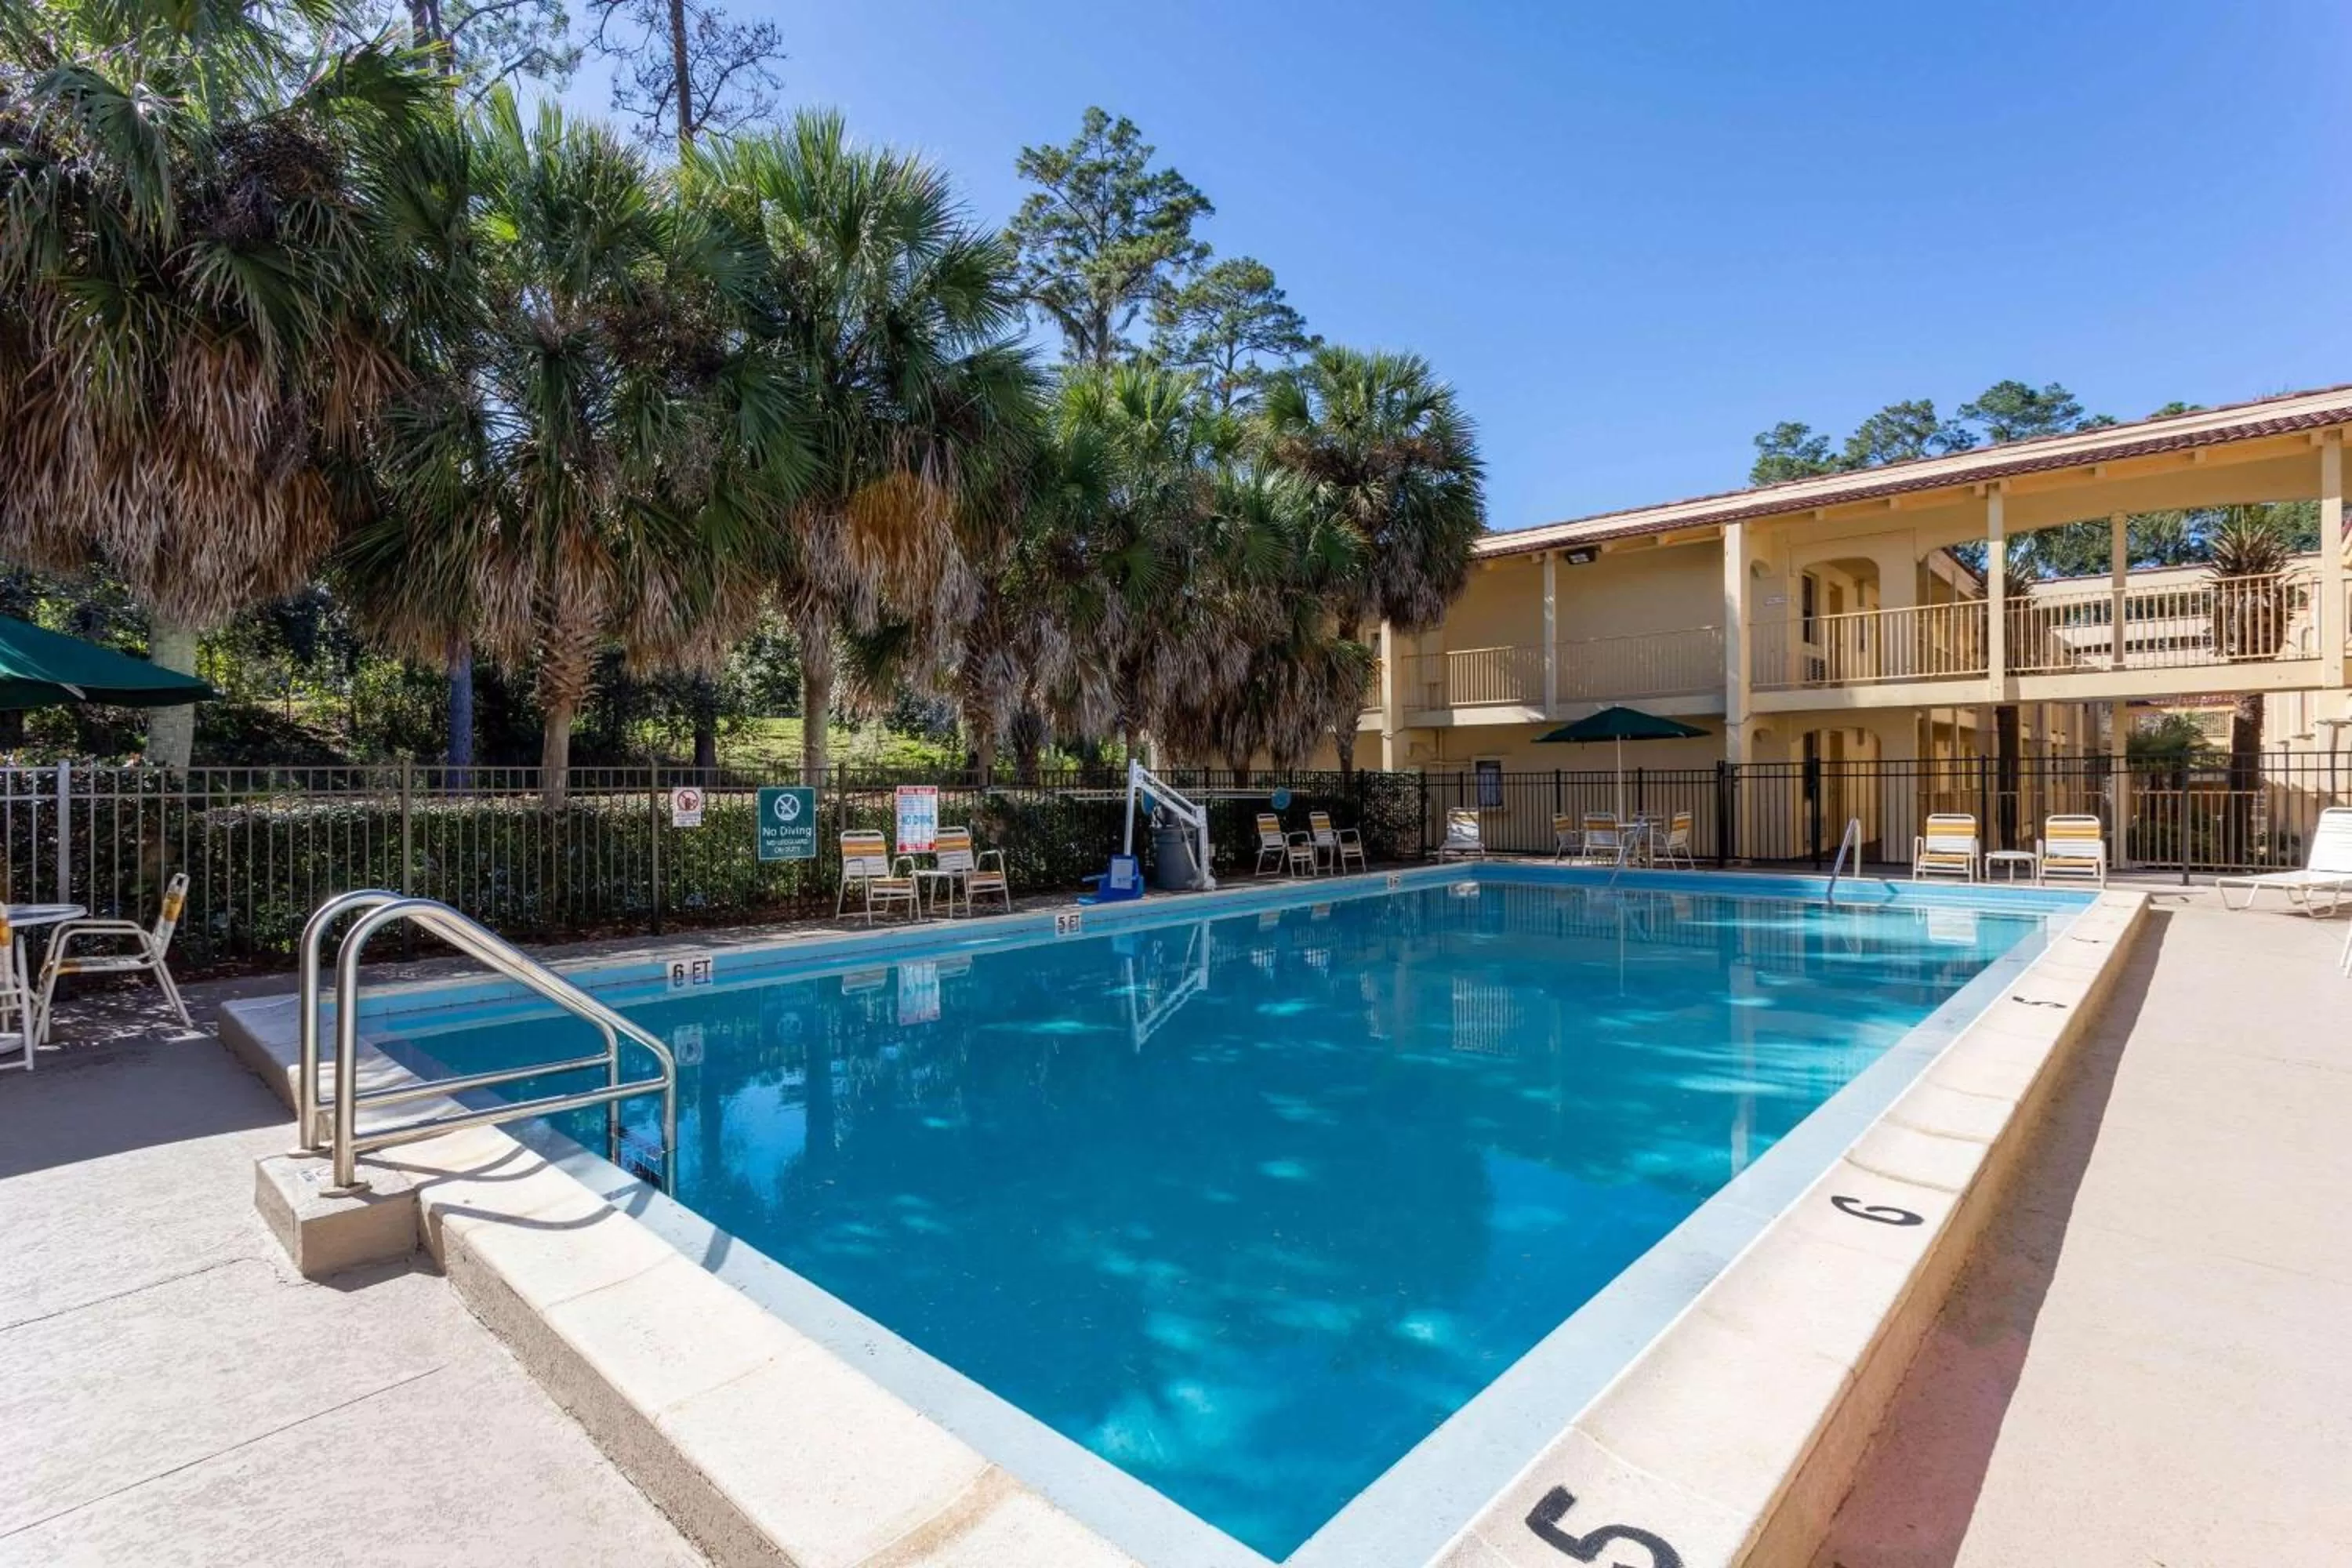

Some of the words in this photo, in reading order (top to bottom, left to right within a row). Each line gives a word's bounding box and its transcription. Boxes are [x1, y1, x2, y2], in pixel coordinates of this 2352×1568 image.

[762, 827, 777, 837] No
[780, 826, 811, 838] Diving
[673, 964, 684, 982] 6
[1831, 1196, 1924, 1226] 6
[1525, 1486, 1683, 1568] 5
